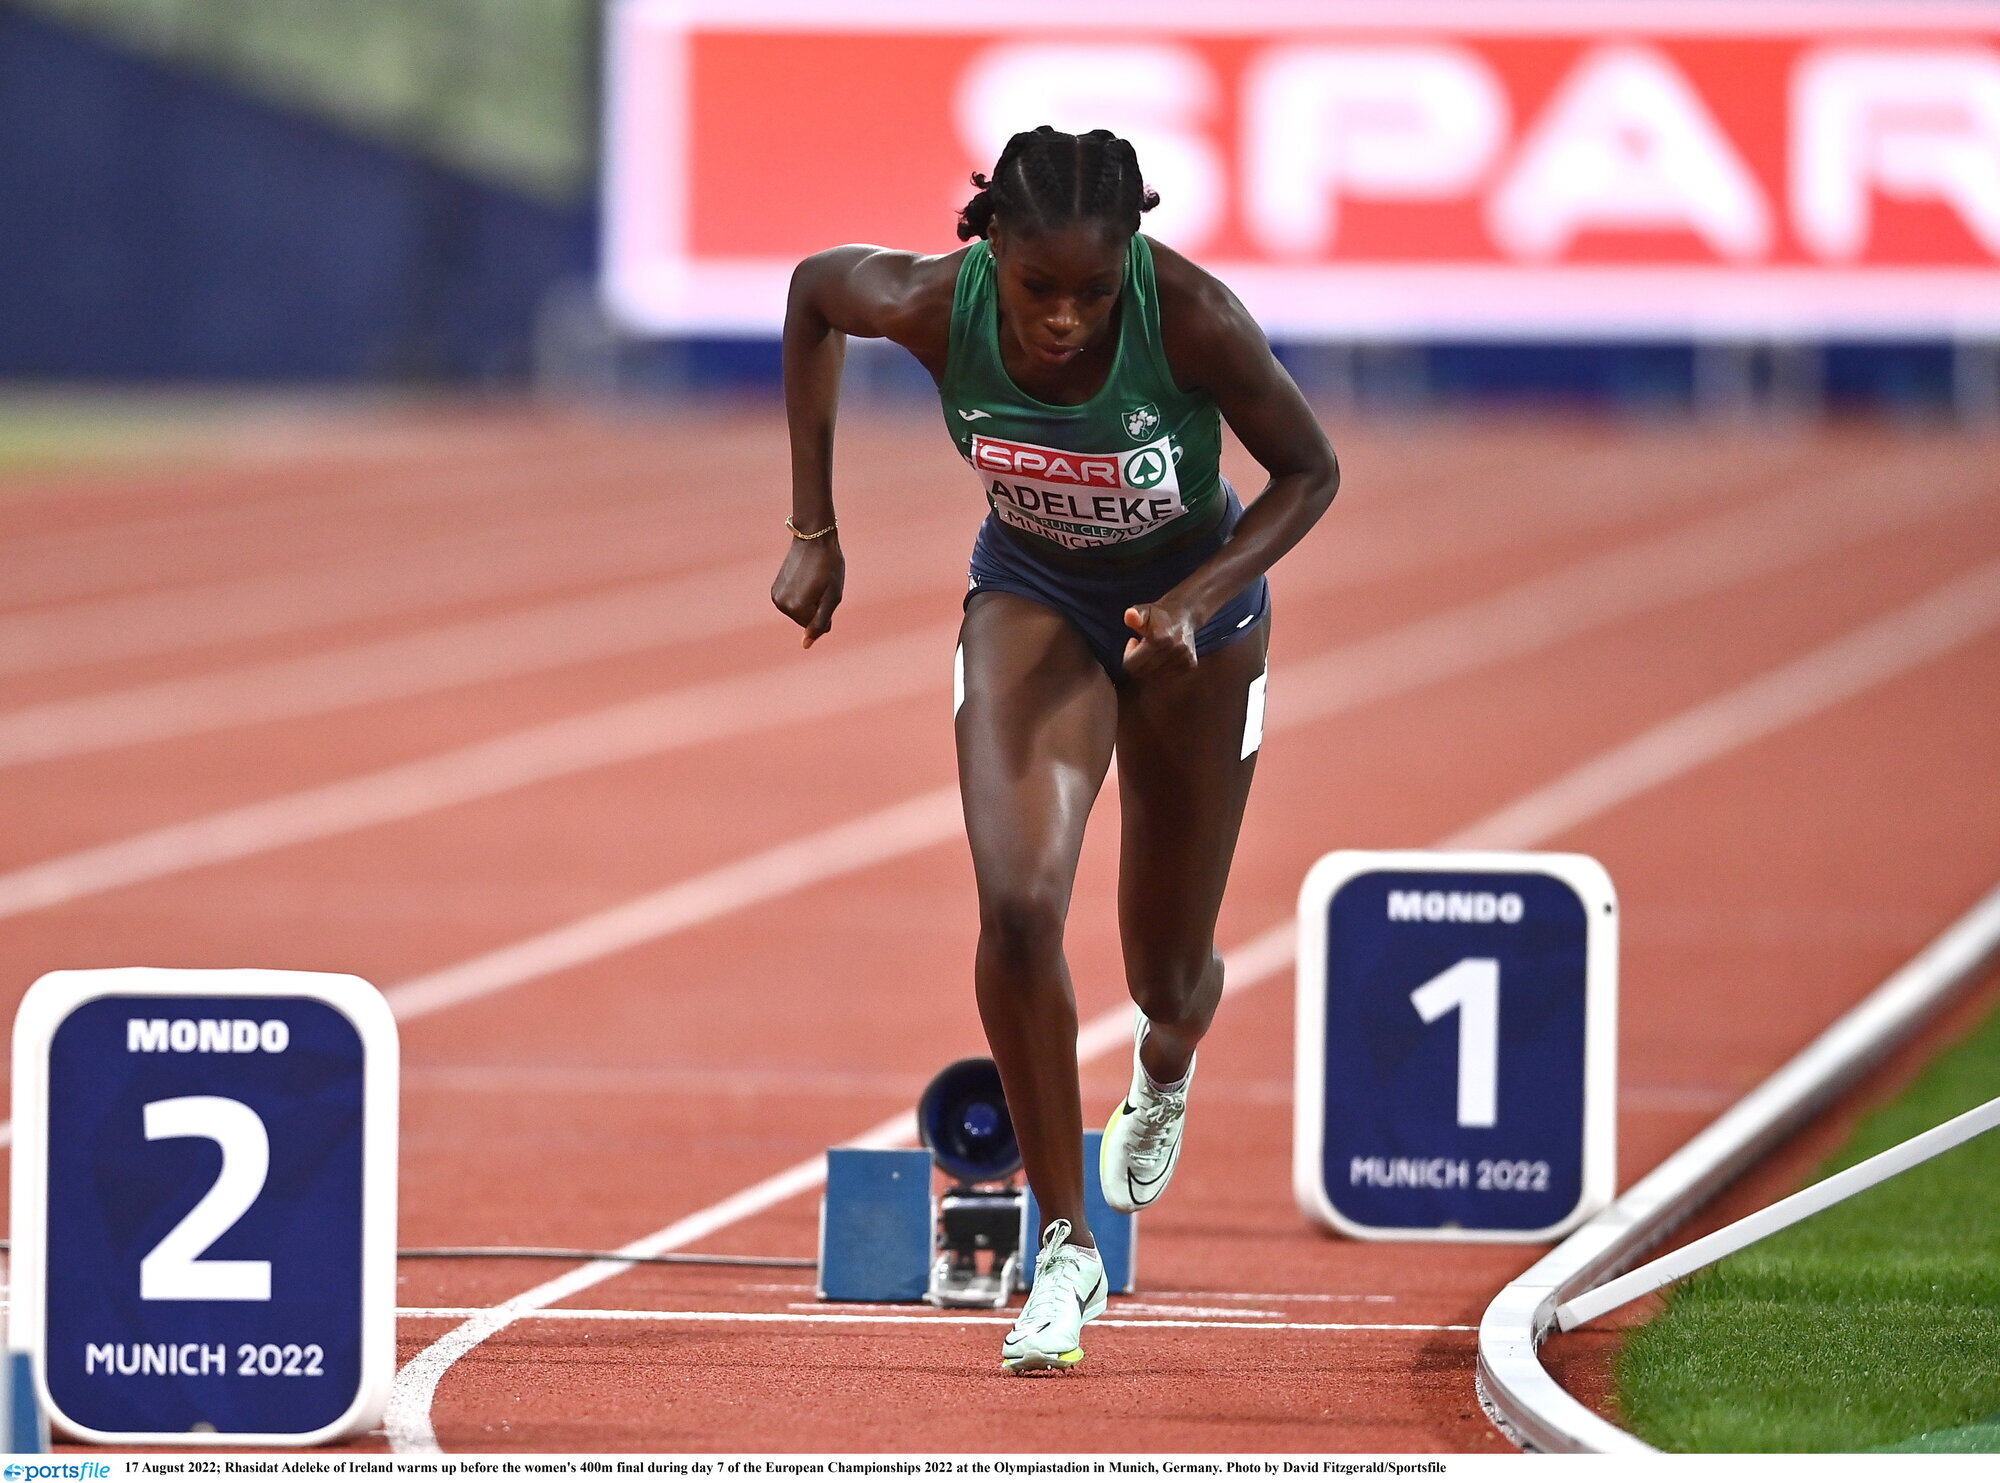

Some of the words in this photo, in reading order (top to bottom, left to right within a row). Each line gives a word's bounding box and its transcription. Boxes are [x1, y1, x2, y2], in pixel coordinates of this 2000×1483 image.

[955, 42, 2000, 262] SPAR
[980, 445, 1116, 485] SPAR
[991, 479, 1173, 524] ADELEKE
[1041, 518, 1076, 533] RUN
[1386, 889, 1525, 924] MONDO
[127, 1018, 290, 1054] MONDO
[1410, 956, 1500, 1130] 1
[1350, 1156, 1469, 1189] MUNICH
[1475, 1159, 1553, 1192] 2022
[140, 1095, 272, 1301] 2
[85, 1342, 226, 1376] MUNICH
[237, 1343, 325, 1377] 2022
